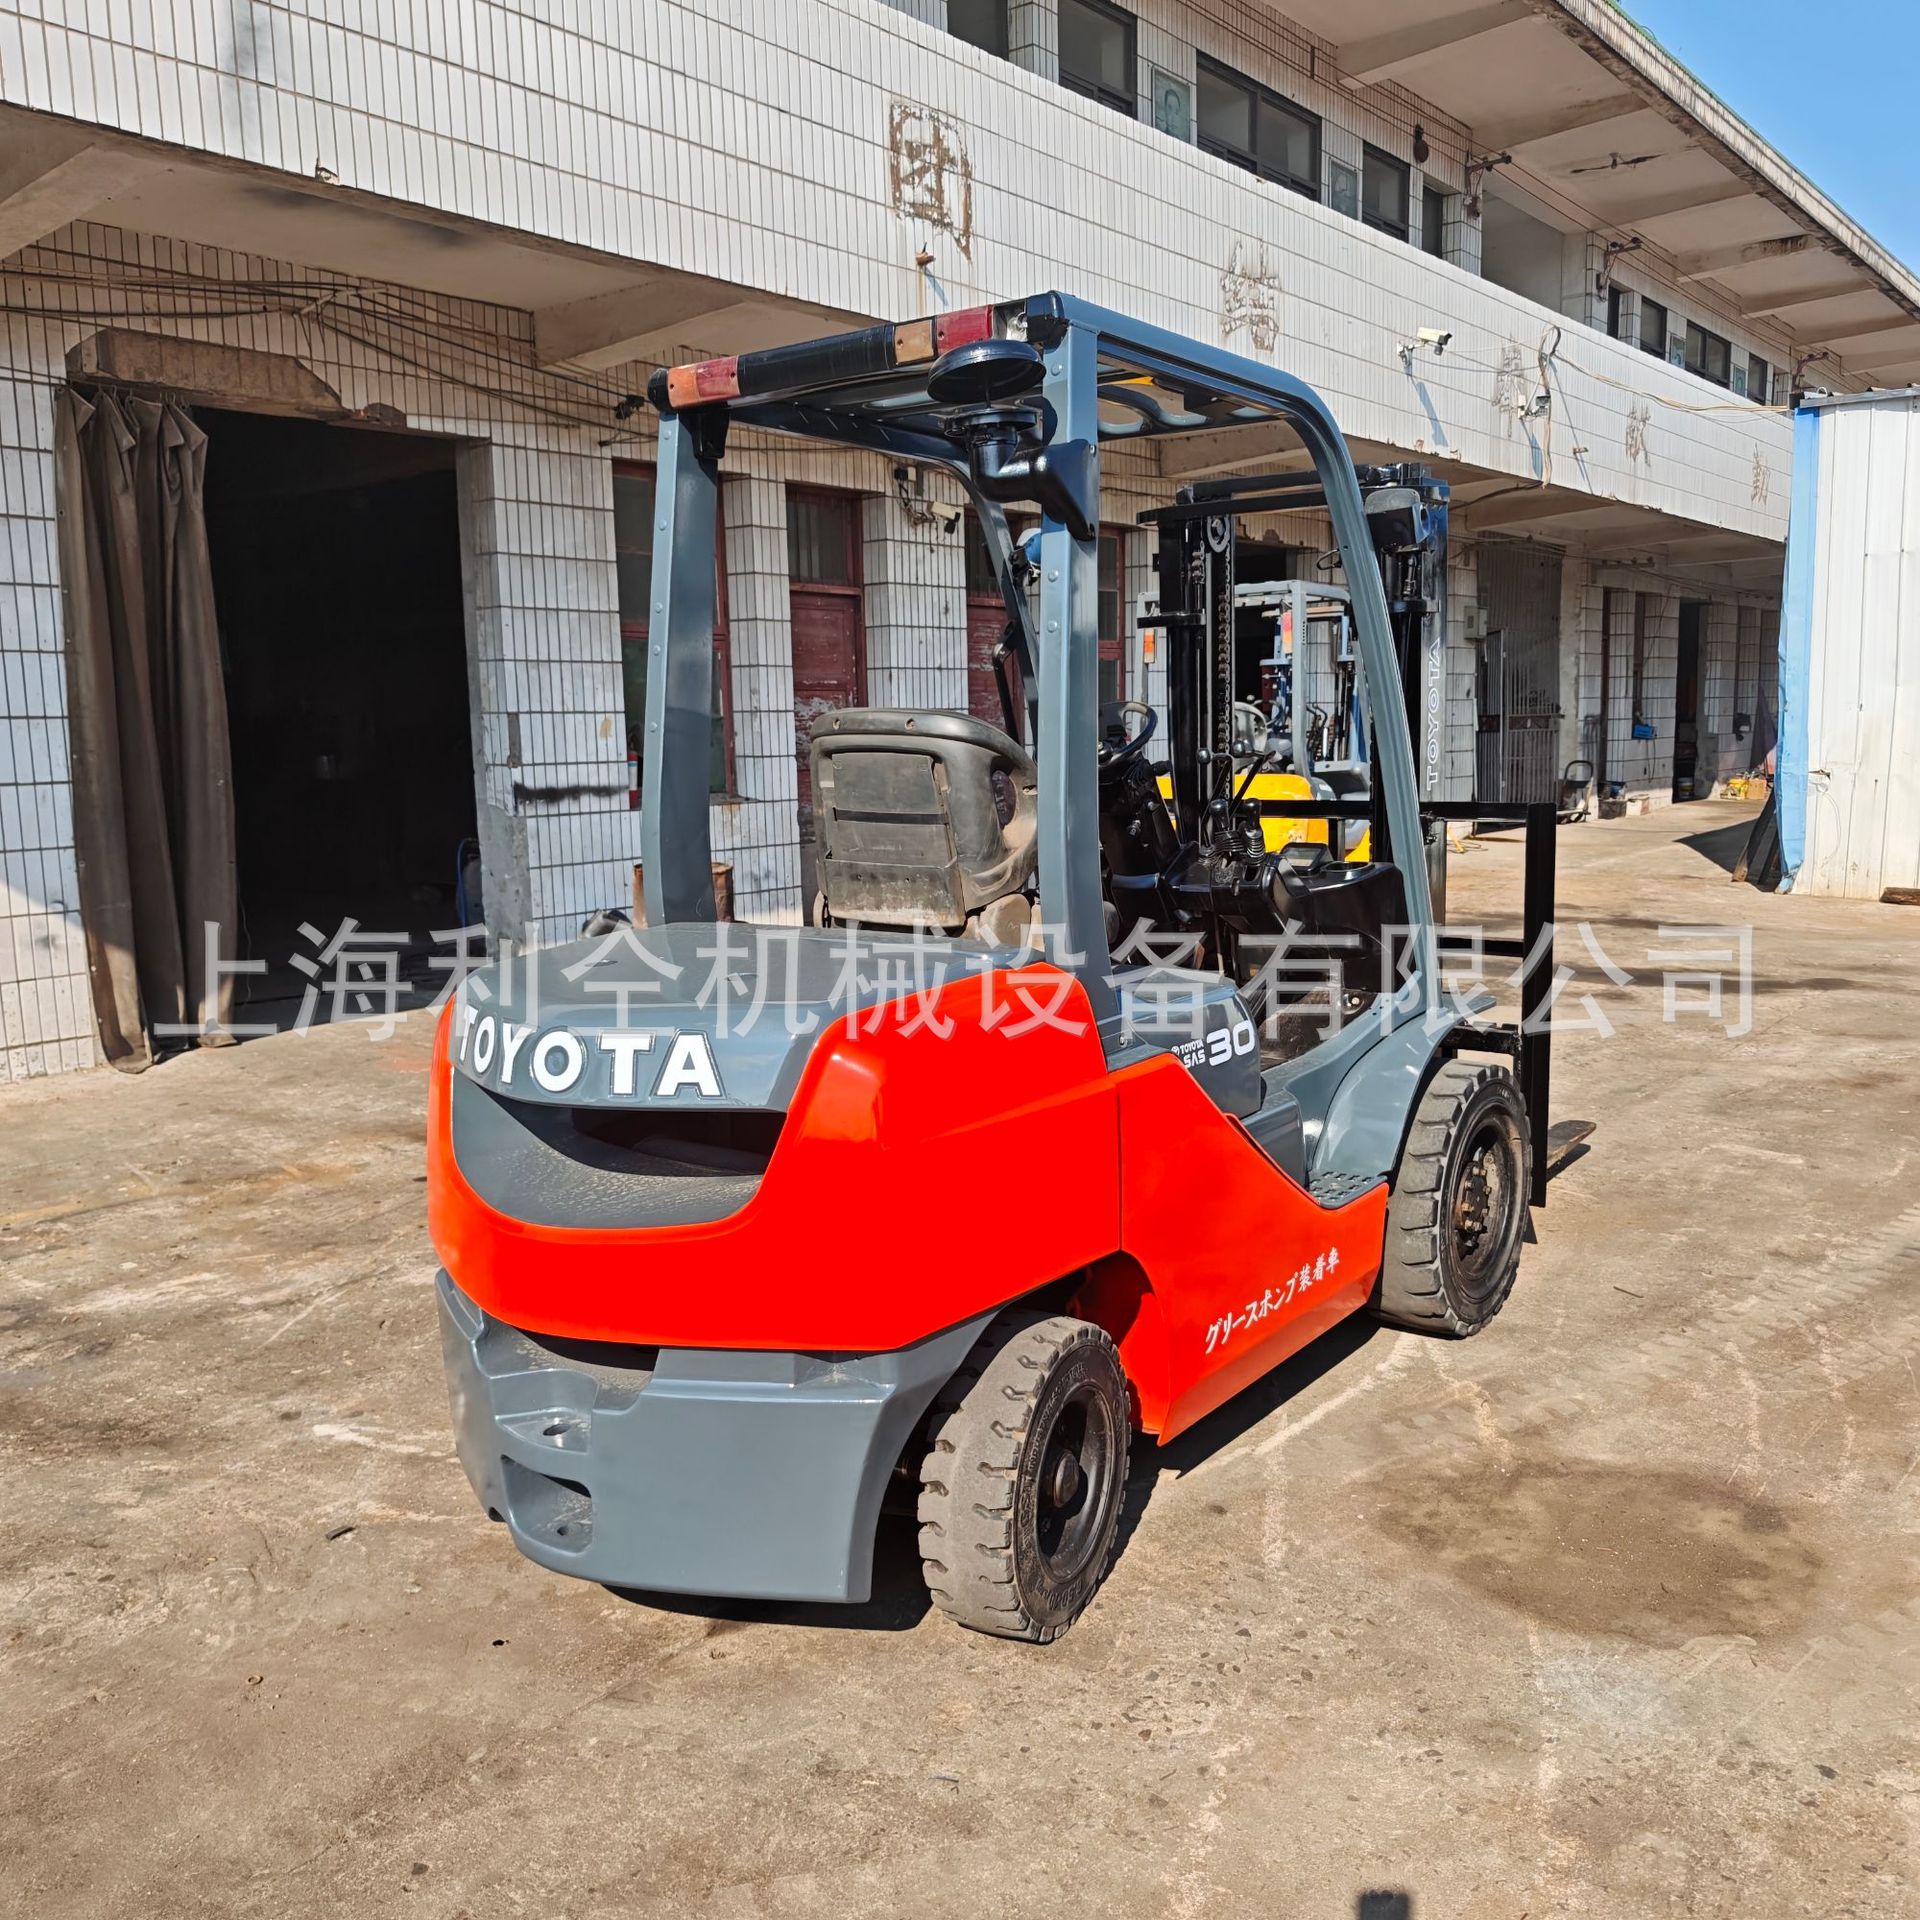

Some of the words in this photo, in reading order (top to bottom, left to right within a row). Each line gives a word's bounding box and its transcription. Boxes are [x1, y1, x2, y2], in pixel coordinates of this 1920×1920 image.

[1426, 637, 1441, 792] TOYOTA
[457, 1003, 724, 1098] TOYOTA
[1180, 1039, 1204, 1054] TOYOTA
[1206, 1020, 1256, 1067] 30
[1183, 1049, 1206, 1069] SAS
